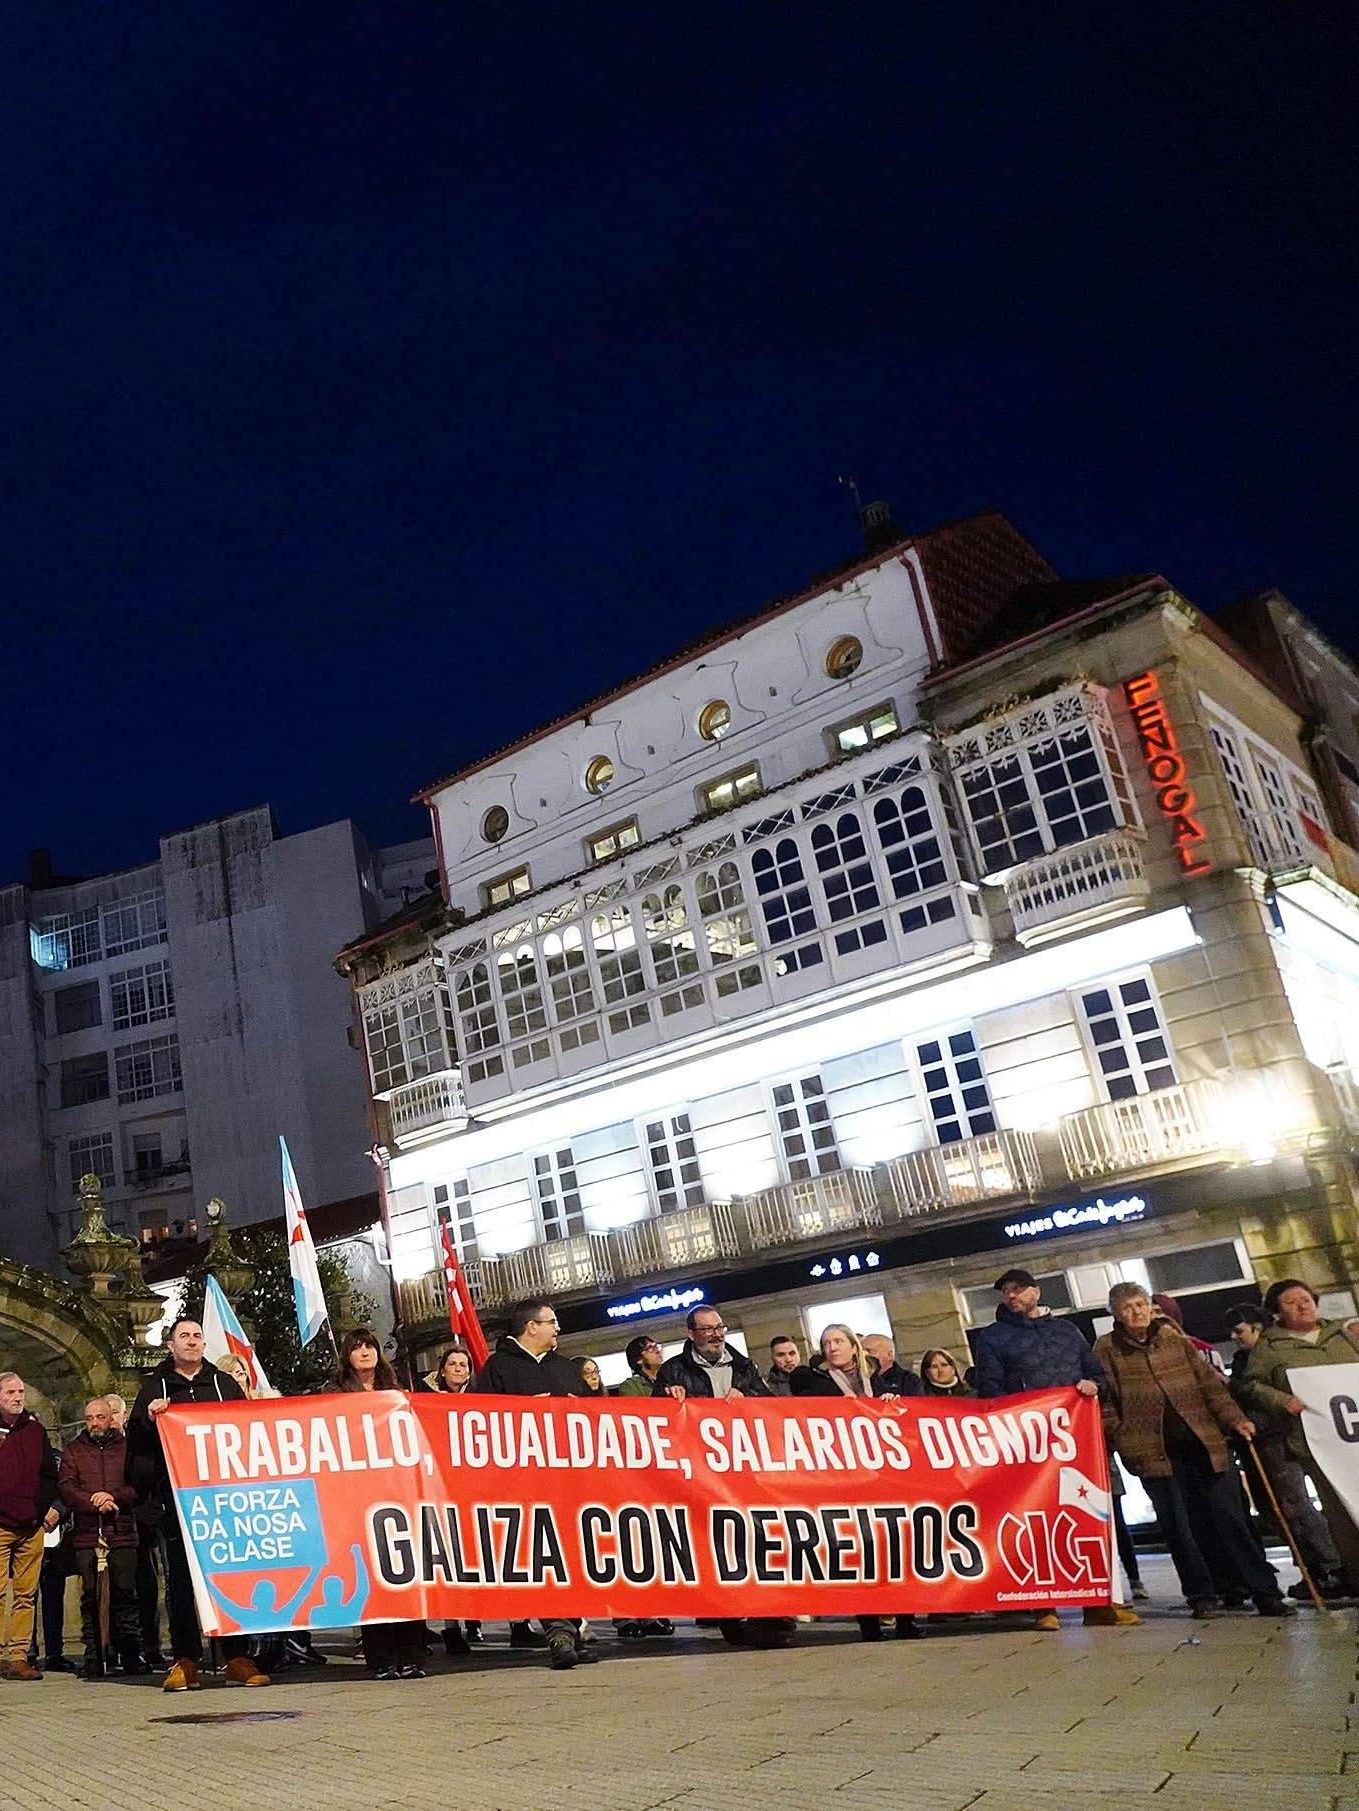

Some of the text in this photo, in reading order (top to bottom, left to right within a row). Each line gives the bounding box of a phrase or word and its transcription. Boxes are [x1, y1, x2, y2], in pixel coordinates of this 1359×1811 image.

[186, 1408, 1077, 1481] TRABALLO, IGUALDADE, SALARIOS DIGNOS
[190, 1487, 300, 1516] A FORZA
[192, 1511, 307, 1541] DA NOSA
[209, 1536, 295, 1564] CLASE
[370, 1504, 986, 1587] GALIZA CON DEREITOS
[997, 1510, 1109, 1586] CIG
